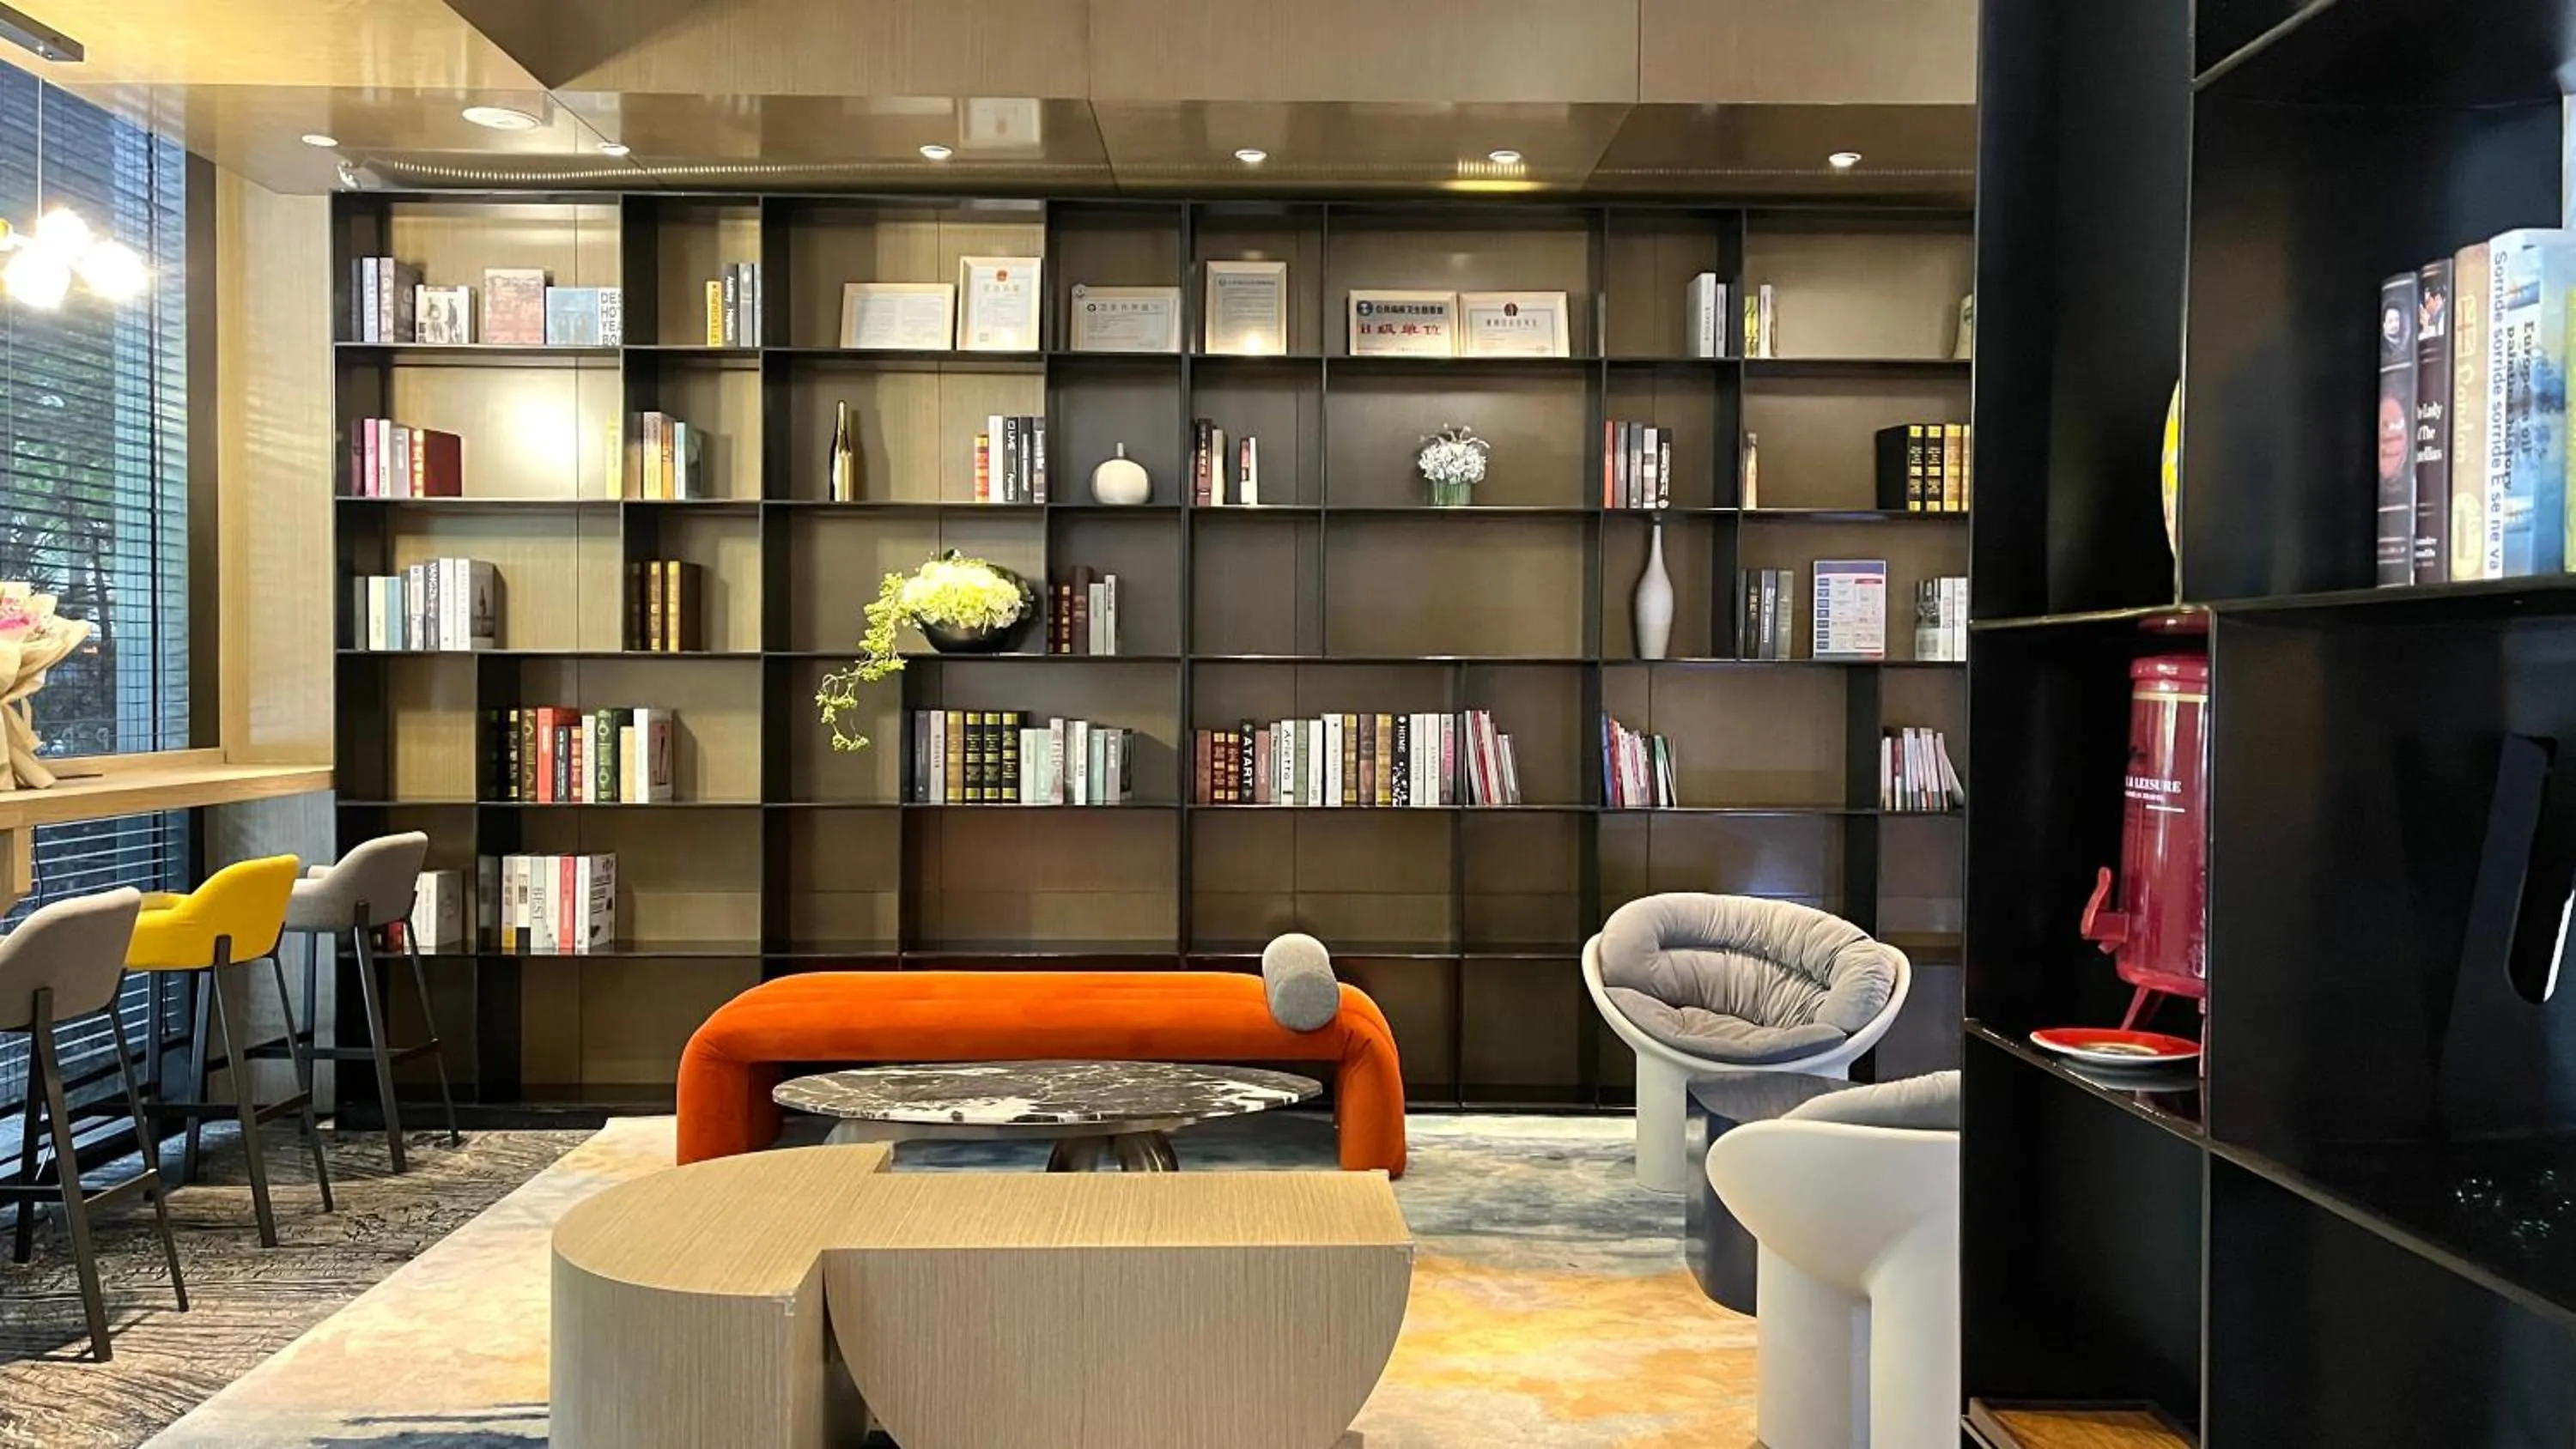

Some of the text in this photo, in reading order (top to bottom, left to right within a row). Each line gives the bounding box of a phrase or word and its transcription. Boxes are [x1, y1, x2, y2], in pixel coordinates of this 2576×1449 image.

[2494, 250, 2507, 323] Sorride
[2493, 328, 2506, 395] sorride
[2491, 401, 2506, 468] sorride
[2491, 492, 2501, 512] se
[2490, 519, 2500, 541] ne
[2489, 549, 2500, 570] va
